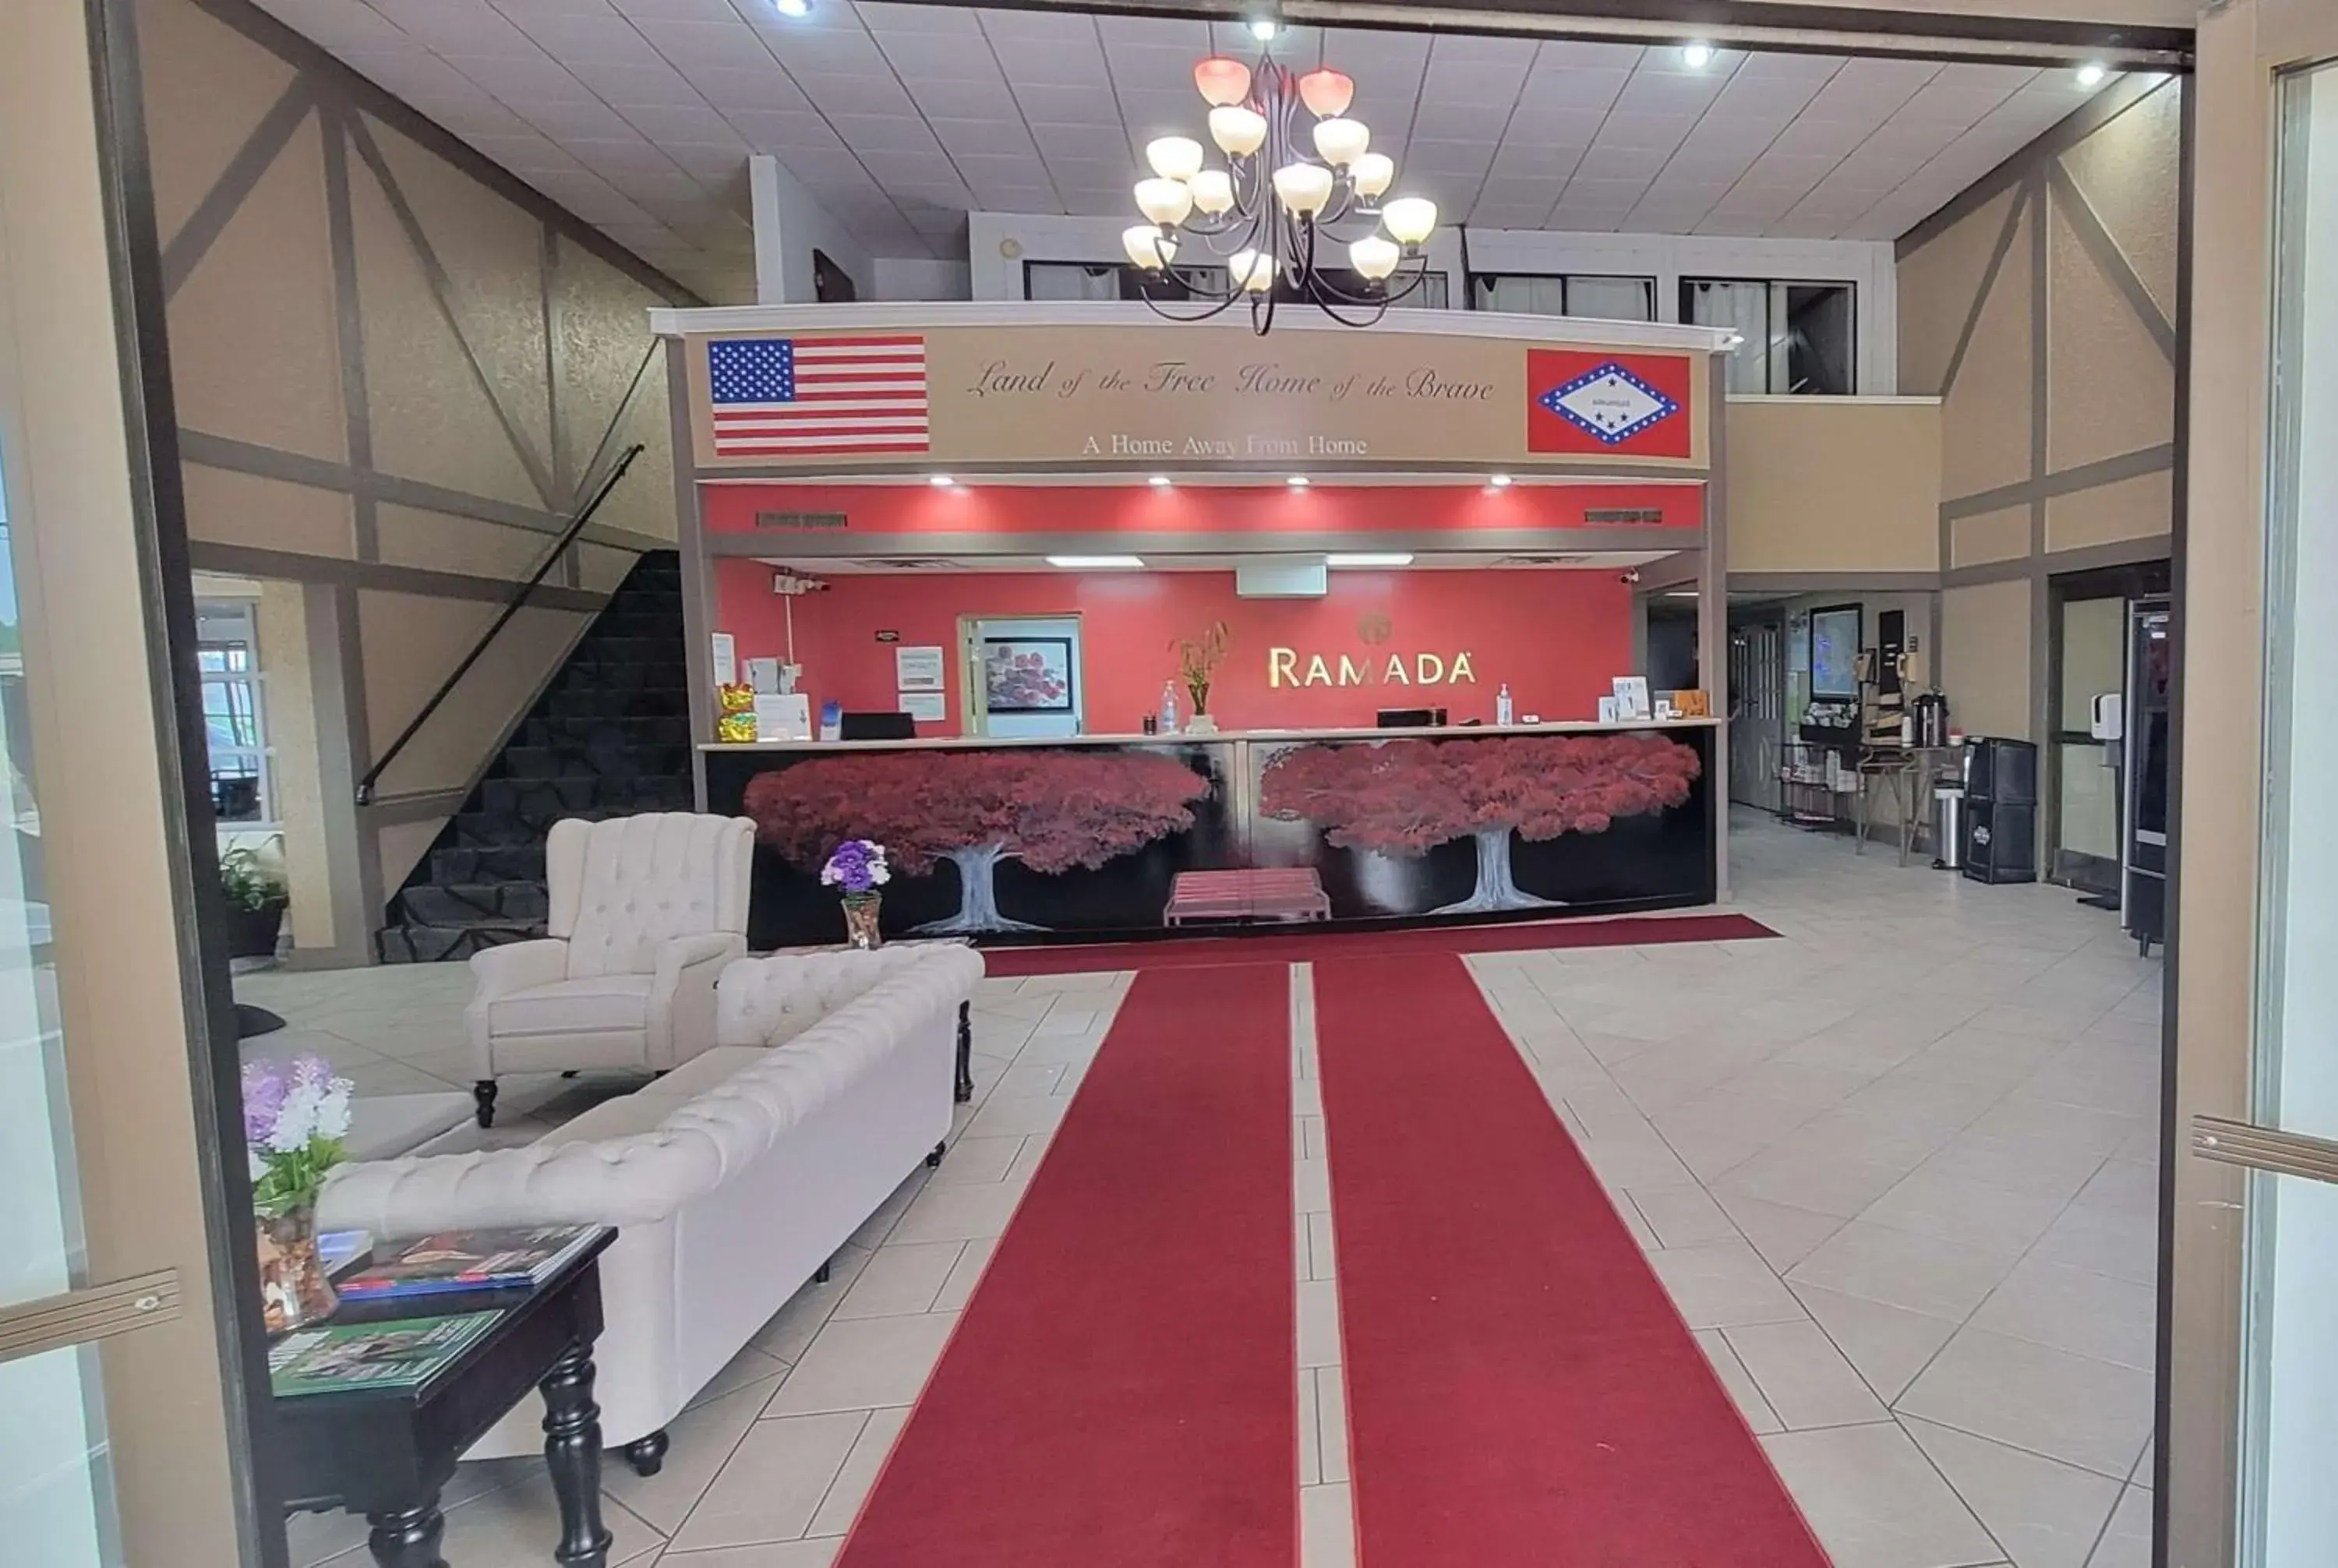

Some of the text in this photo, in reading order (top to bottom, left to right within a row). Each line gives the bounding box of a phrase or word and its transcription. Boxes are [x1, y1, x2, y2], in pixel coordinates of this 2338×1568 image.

[967, 360, 1494, 401] Land of the Free Home of the Brave
[1082, 435, 1369, 458] A Home Away From Home
[1269, 647, 1476, 688] RAMADA
